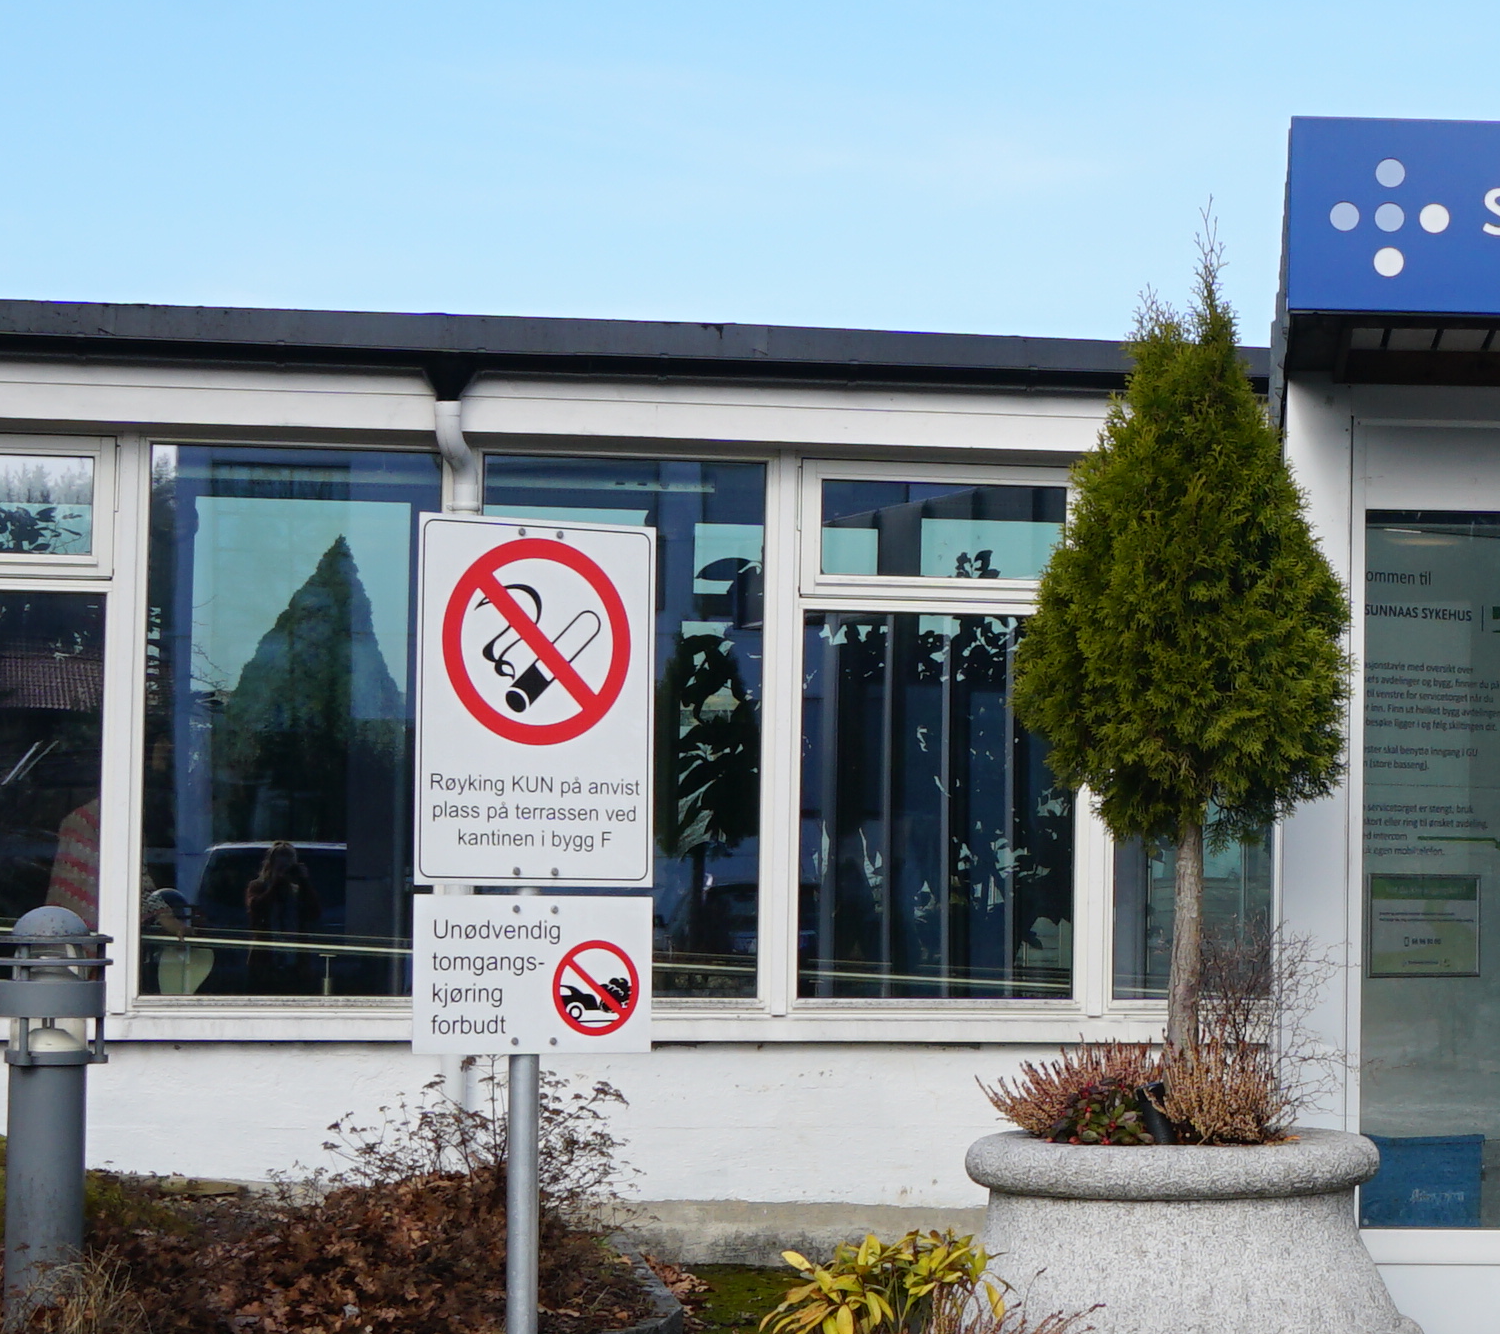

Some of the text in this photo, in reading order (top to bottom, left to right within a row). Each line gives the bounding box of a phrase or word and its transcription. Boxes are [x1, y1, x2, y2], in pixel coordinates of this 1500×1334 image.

[1419, 571, 1431, 585] til
[1421, 607, 1472, 622] SYKEHUS
[1407, 663, 1424, 672] med
[1426, 664, 1455, 673] oversikt
[1457, 666, 1473, 674] over
[1381, 676, 1420, 687] avdelinger
[1479, 680, 1489, 689] du
[1490, 680, 1500, 690] på
[1376, 691, 1404, 699] venstre
[1406, 690, 1417, 699] for
[1419, 692, 1468, 703] servicetorget
[1483, 694, 1493, 703] du
[1387, 704, 1404, 713] Finn
[1383, 745, 1398, 754] skal
[1400, 745, 1429, 756] benytte
[430, 773, 641, 798] Røyking KUN på anvist
[432, 801, 636, 823] plass på terrassen ved
[1367, 804, 1417, 814] servicetorget
[1419, 805, 1428, 813] er
[1456, 805, 1474, 814] bruk
[1384, 818, 1401, 826] eller
[1403, 818, 1418, 829] ring
[458, 829, 612, 853] kantinen i bygg F
[434, 919, 561, 945] Unødvendig
[432, 952, 545, 976] tomgangs-
[432, 983, 503, 1008] kjøring
[431, 1014, 506, 1035] forbudt
